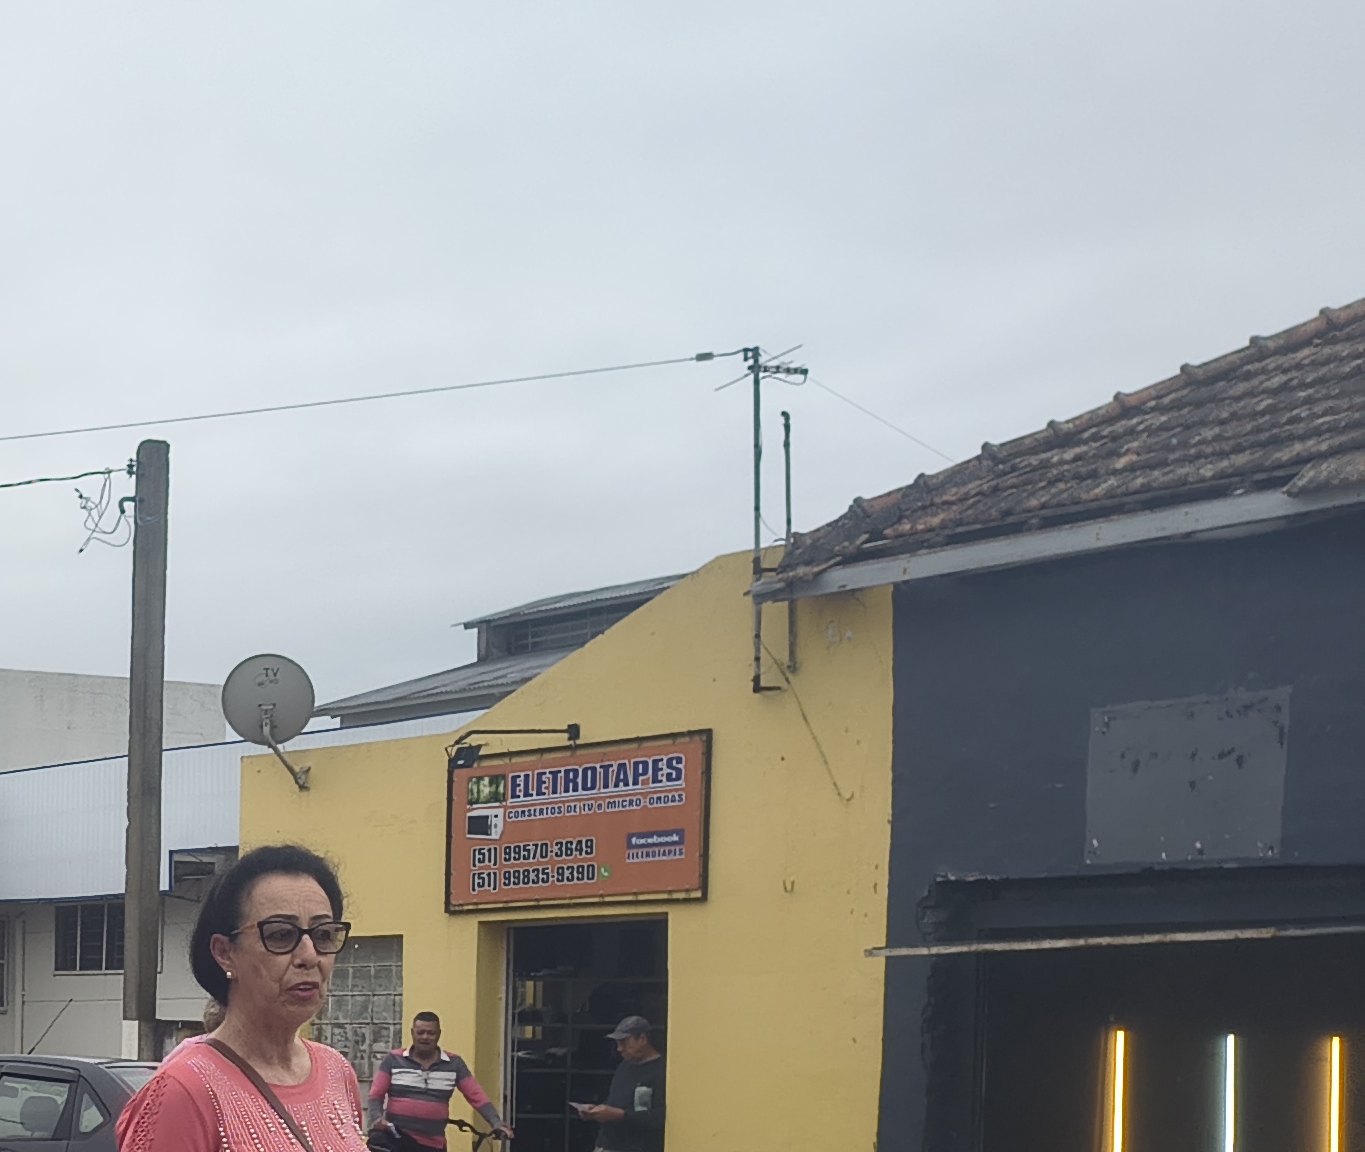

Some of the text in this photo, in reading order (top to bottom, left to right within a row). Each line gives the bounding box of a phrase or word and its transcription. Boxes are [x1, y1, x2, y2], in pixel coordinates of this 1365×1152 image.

[509, 755, 684, 802] ELETROTAPES
[507, 807, 562, 820] CONSERTOS
[566, 804, 577, 814] DE
[472, 838, 594, 868] (51) 99570-3649
[631, 834, 679, 845] facebook
[471, 863, 596, 892] (51) 99835-9390
